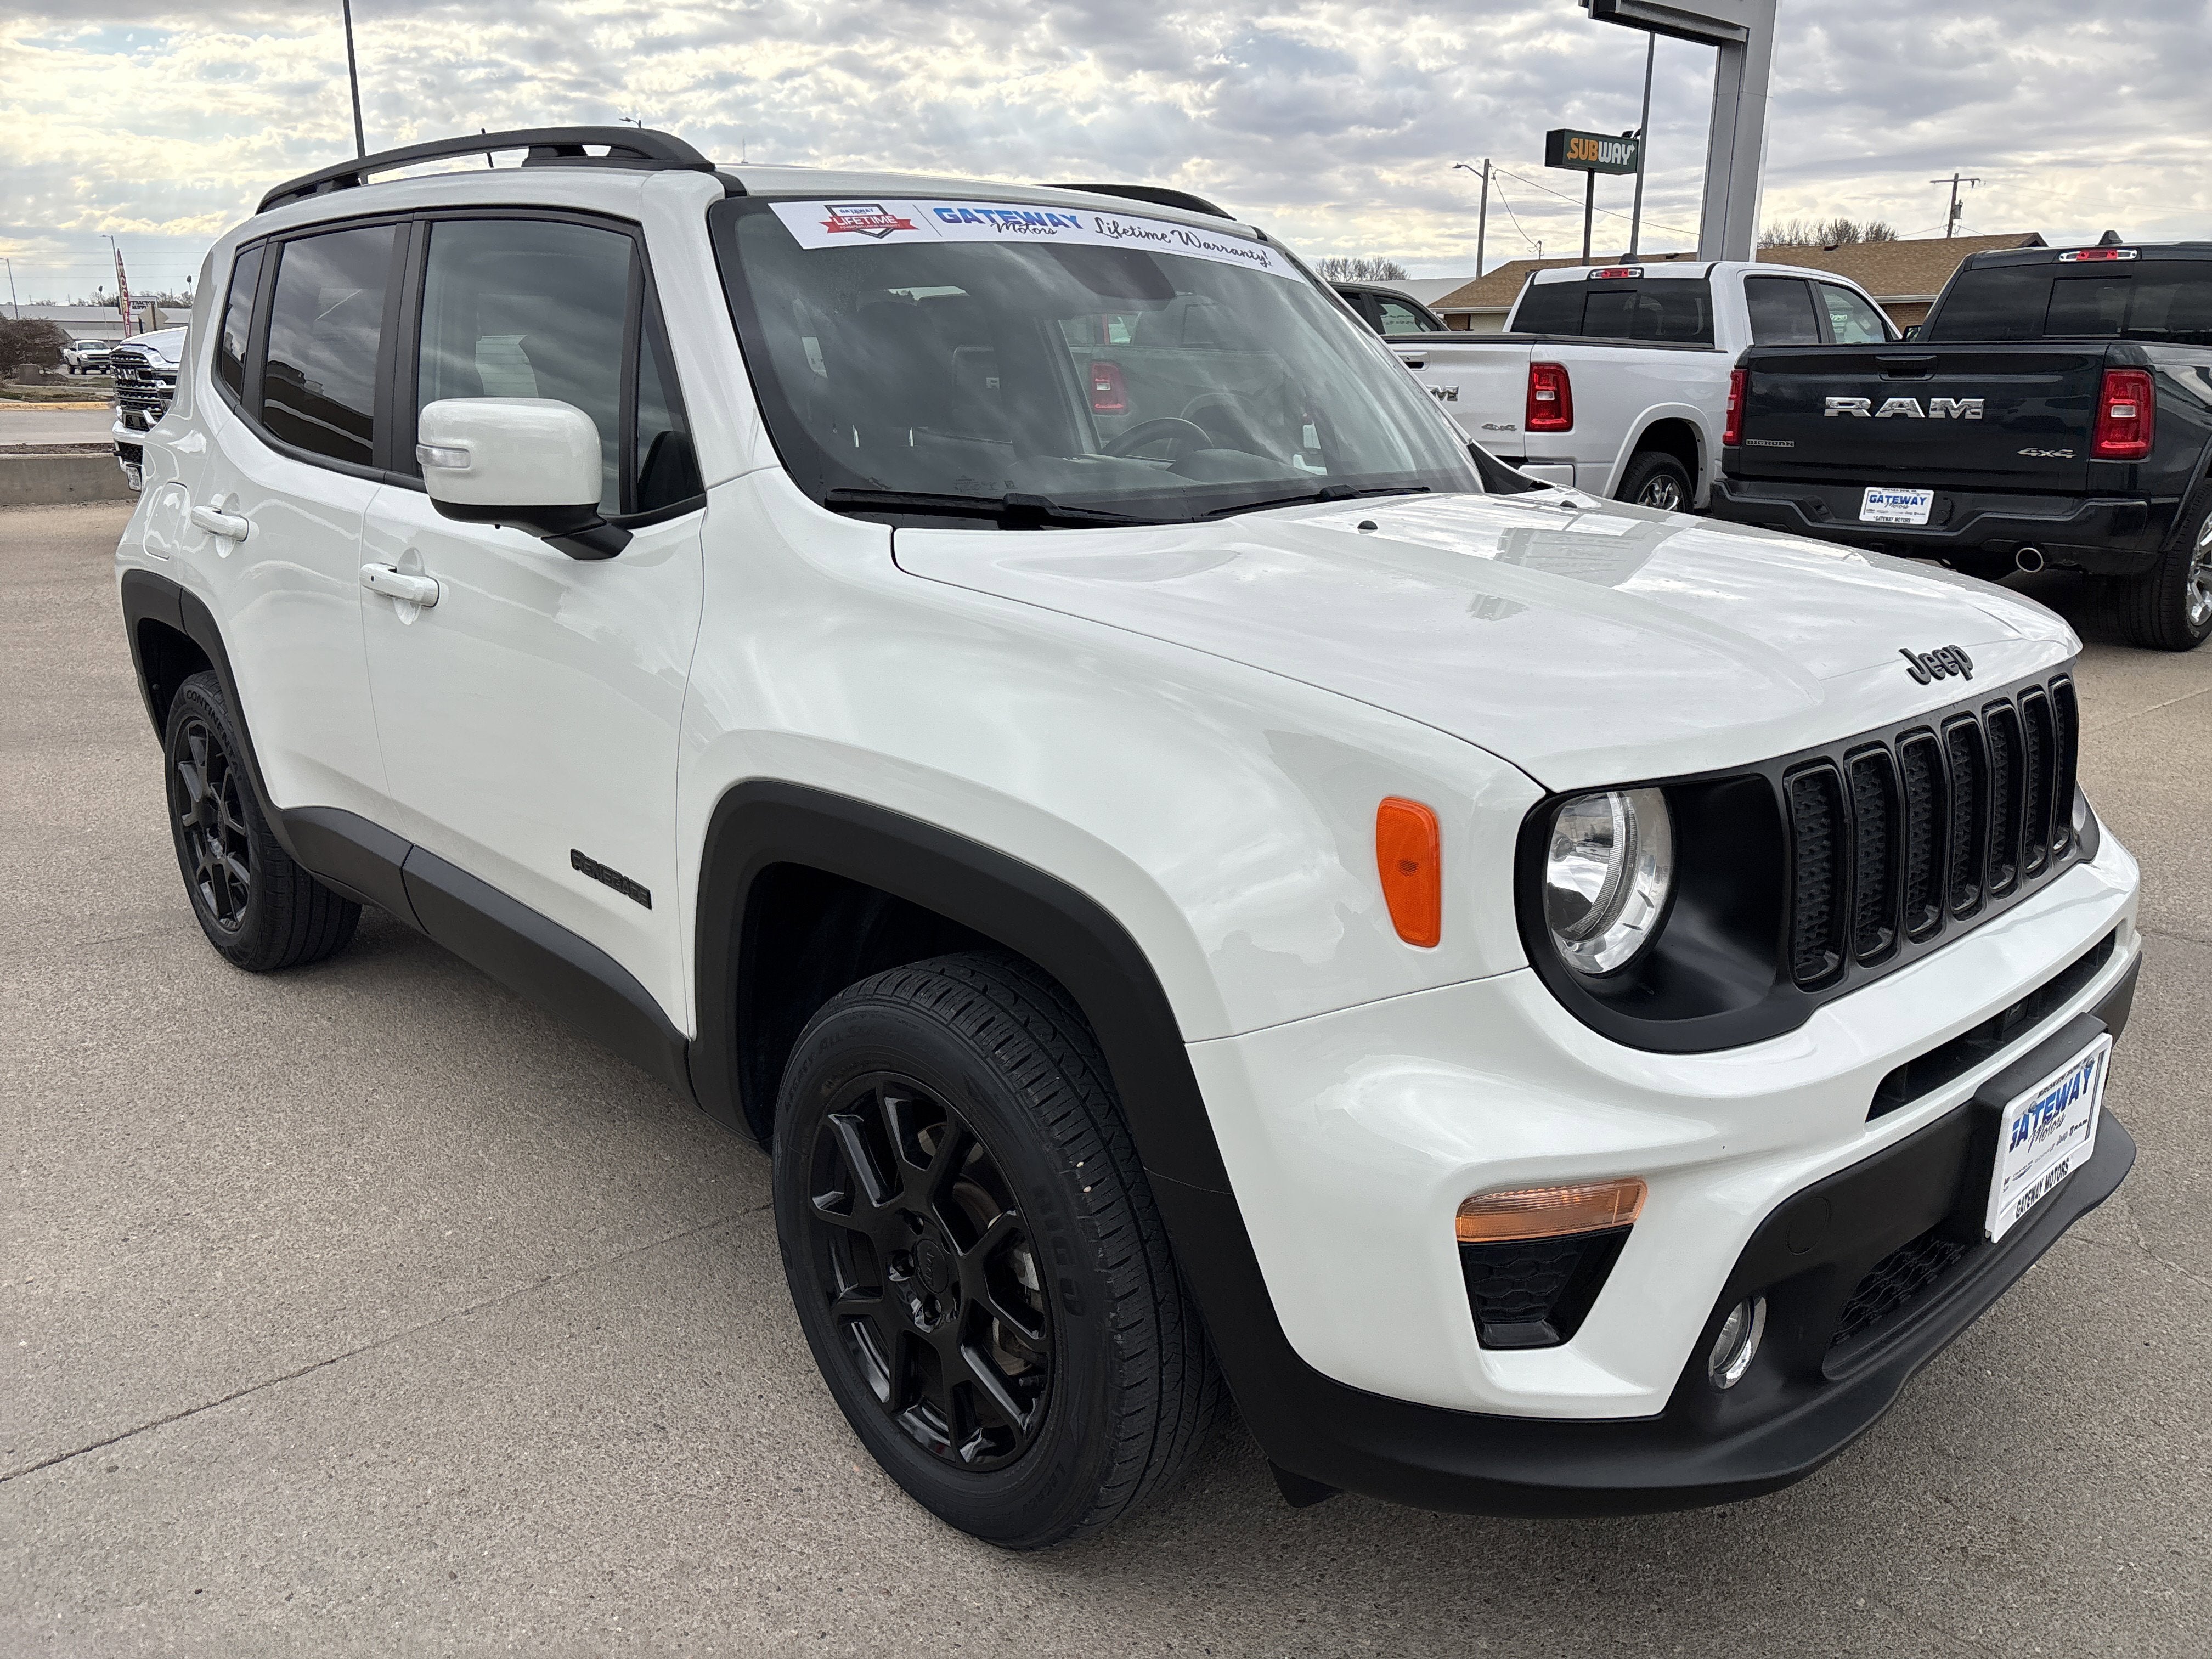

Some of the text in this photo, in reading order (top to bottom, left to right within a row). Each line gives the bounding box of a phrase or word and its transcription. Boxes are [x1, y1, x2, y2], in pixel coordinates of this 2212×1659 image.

[1567, 137, 1635, 165] SUBWAY
[833, 215, 898, 225] LIFETIME
[933, 208, 1084, 229] GATEWAY
[990, 222, 1057, 235] Motors
[1094, 216, 1172, 245] Lifetime
[1170, 229, 1272, 268] Warranty!
[1823, 396, 1985, 420] RAM
[1481, 423, 1517, 432] 4x4
[2017, 447, 2078, 459] 4x4
[1869, 495, 1928, 506] GATEWAY
[1898, 645, 1973, 686] Jeep
[571, 848, 653, 910] RENEGADE
[2028, 1109, 2067, 1154] Motors
[2016, 1157, 2069, 1219] GATEWAY MOTORS
